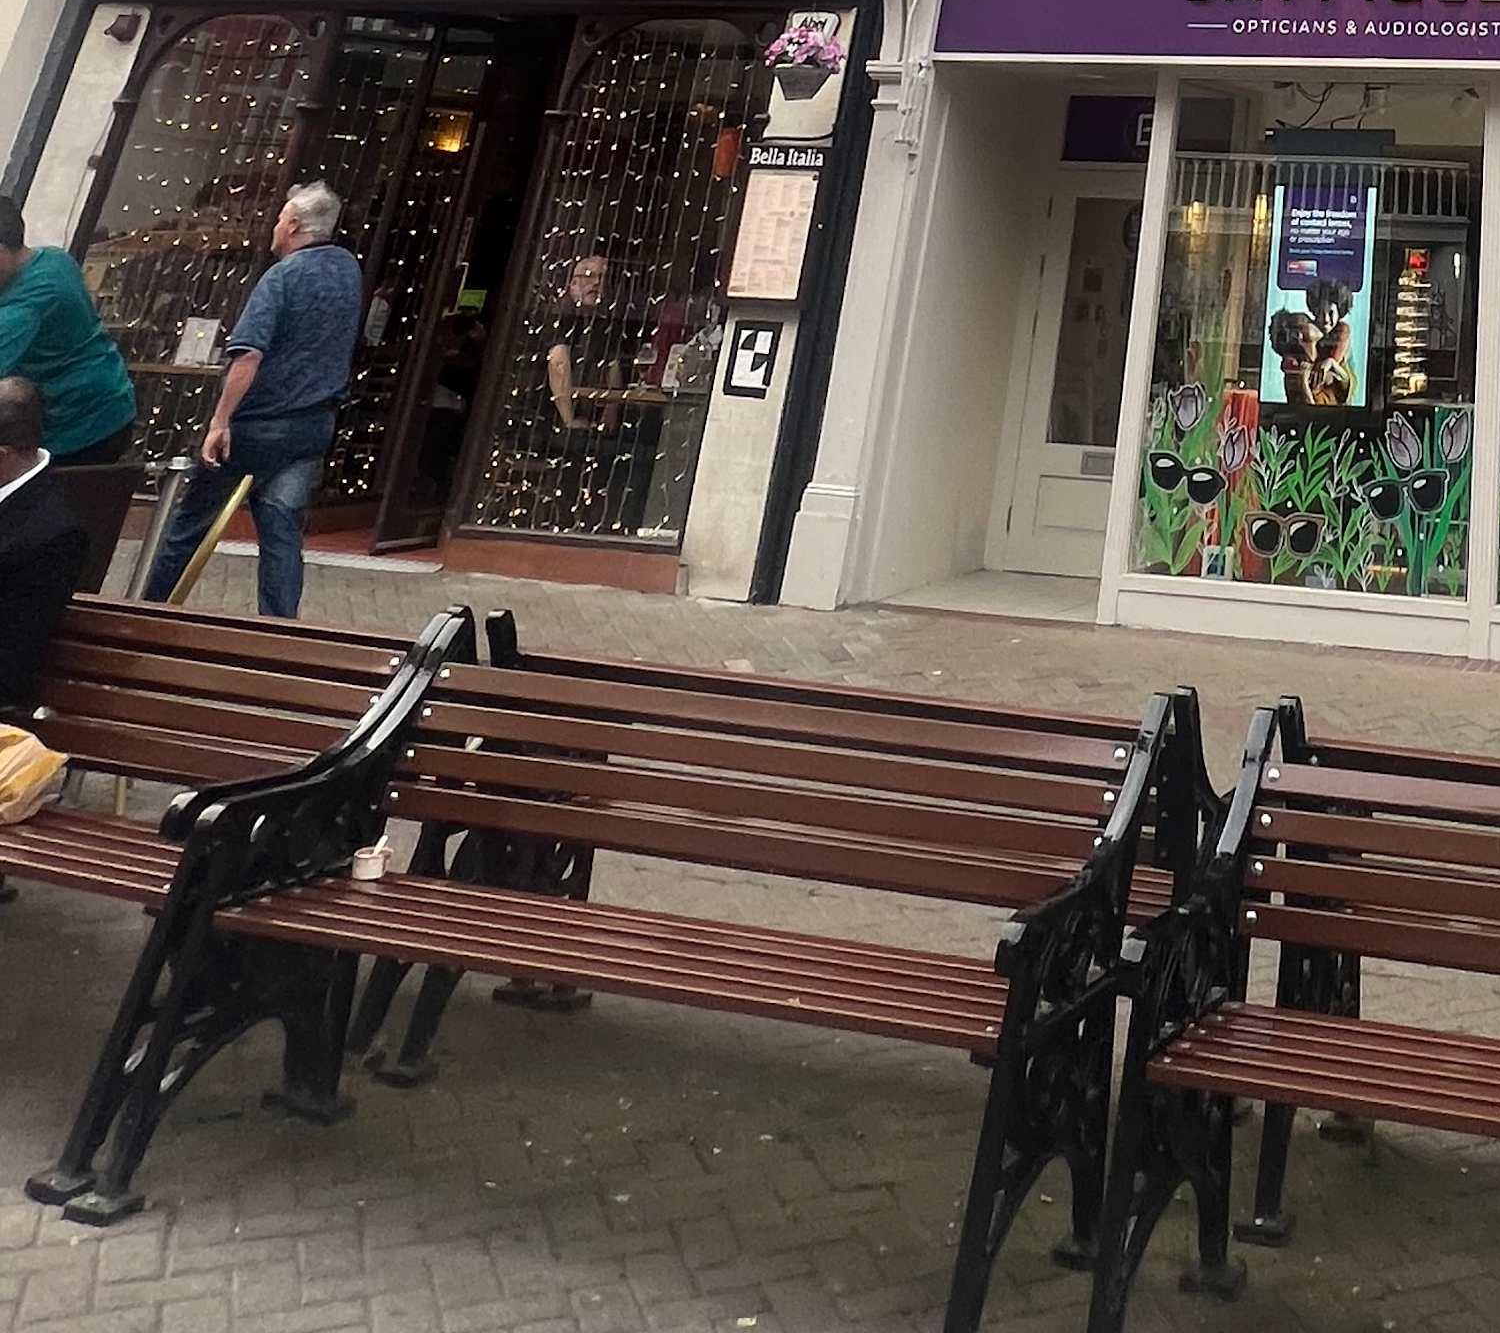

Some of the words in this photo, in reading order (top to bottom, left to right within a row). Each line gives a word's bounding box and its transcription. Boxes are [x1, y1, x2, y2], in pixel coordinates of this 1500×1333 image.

[1232, 18, 1338, 35] OPTICIANS
[1345, 20, 1358, 35] &
[749, 147, 785, 166] Bella
[786, 148, 824, 167] Italia
